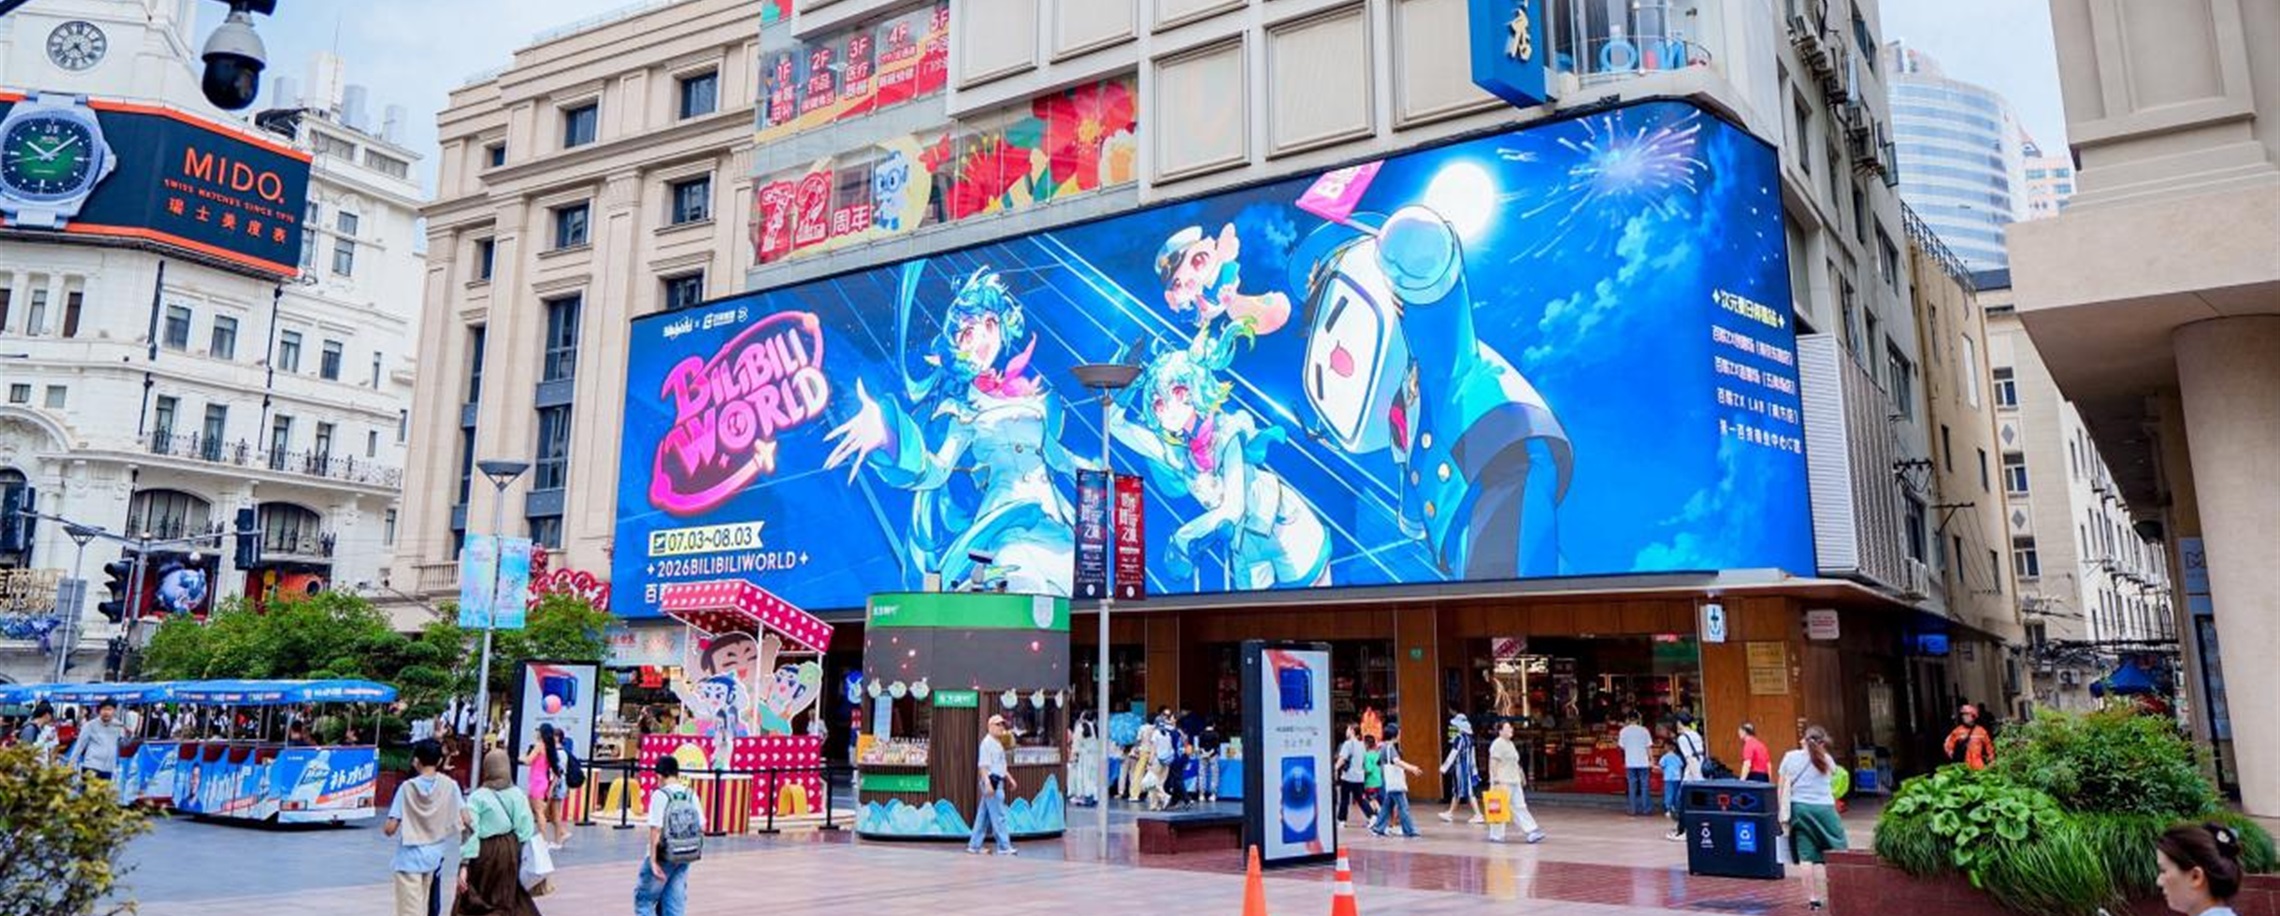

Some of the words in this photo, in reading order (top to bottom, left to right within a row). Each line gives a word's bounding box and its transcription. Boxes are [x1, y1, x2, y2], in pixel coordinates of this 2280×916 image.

[887, 22, 908, 43] 4F
[811, 49, 830, 70] 2F
[849, 36, 869, 58] 3F
[777, 61, 792, 82] 1F
[164, 178, 195, 193] SWISS
[198, 188, 241, 207] WATCHES
[244, 202, 273, 217] SINCE
[168, 197, 288, 243] 瑞士美度表
[661, 328, 808, 425] BILIBILI
[664, 365, 829, 475] WORLD
[668, 526, 752, 551] 07.03~08.03
[657, 551, 796, 577] 2026BILIBILIWORLD
